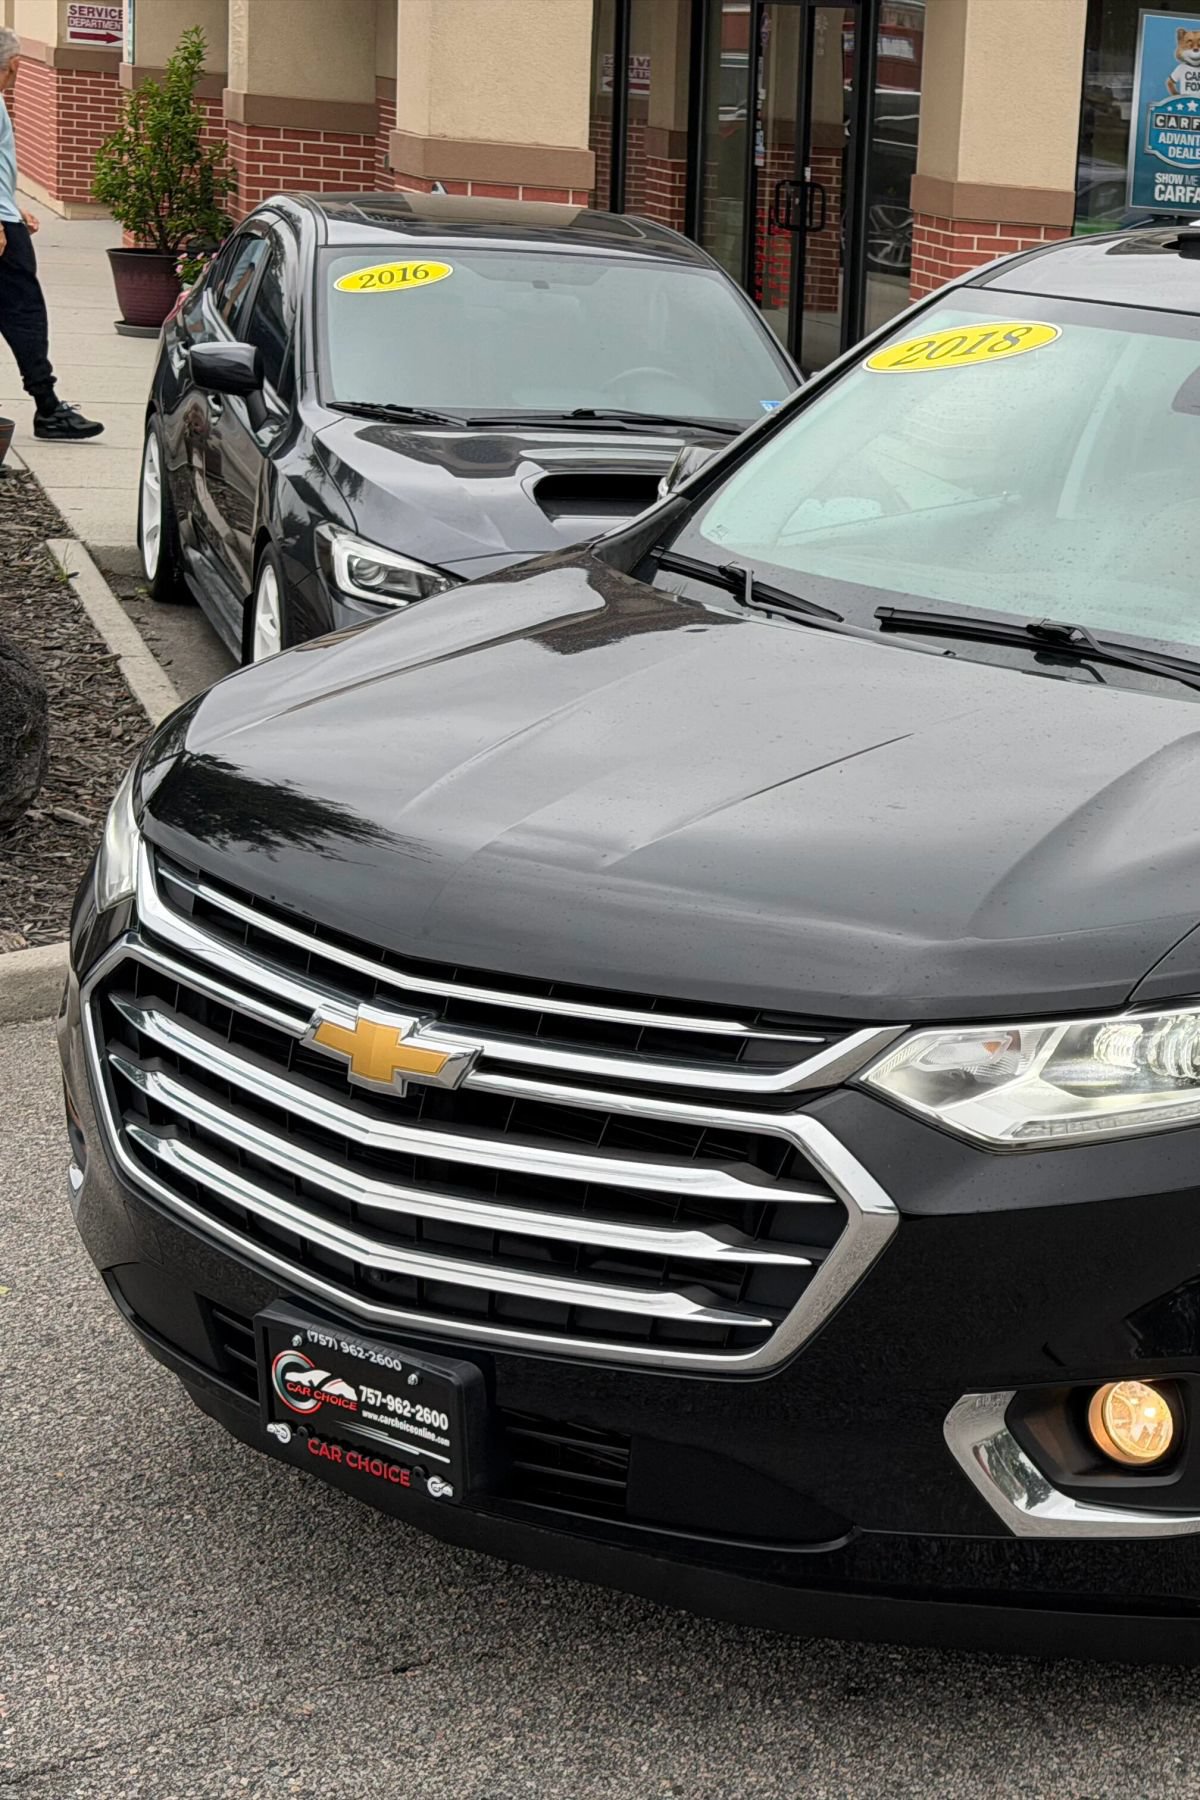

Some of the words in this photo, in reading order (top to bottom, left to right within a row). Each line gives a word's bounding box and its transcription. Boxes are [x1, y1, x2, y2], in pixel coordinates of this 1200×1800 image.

[69, 5, 123, 19] SERVICE
[1154, 172, 1185, 185] SHOW
[1185, 175, 1200, 186] ME
[358, 263, 430, 290] 2016
[888, 326, 1033, 368] 2018
[307, 1329, 339, 1350] (757)
[340, 1341, 402, 1372] 962-2600
[286, 1382, 312, 1398] CAR
[313, 1390, 359, 1412] CHOICE
[359, 1385, 449, 1431] 757-962-2600
[362, 1410, 450, 1447] www.carchoiceonline.com
[307, 1437, 342, 1463] CAR
[345, 1450, 411, 1488] CHOICE
